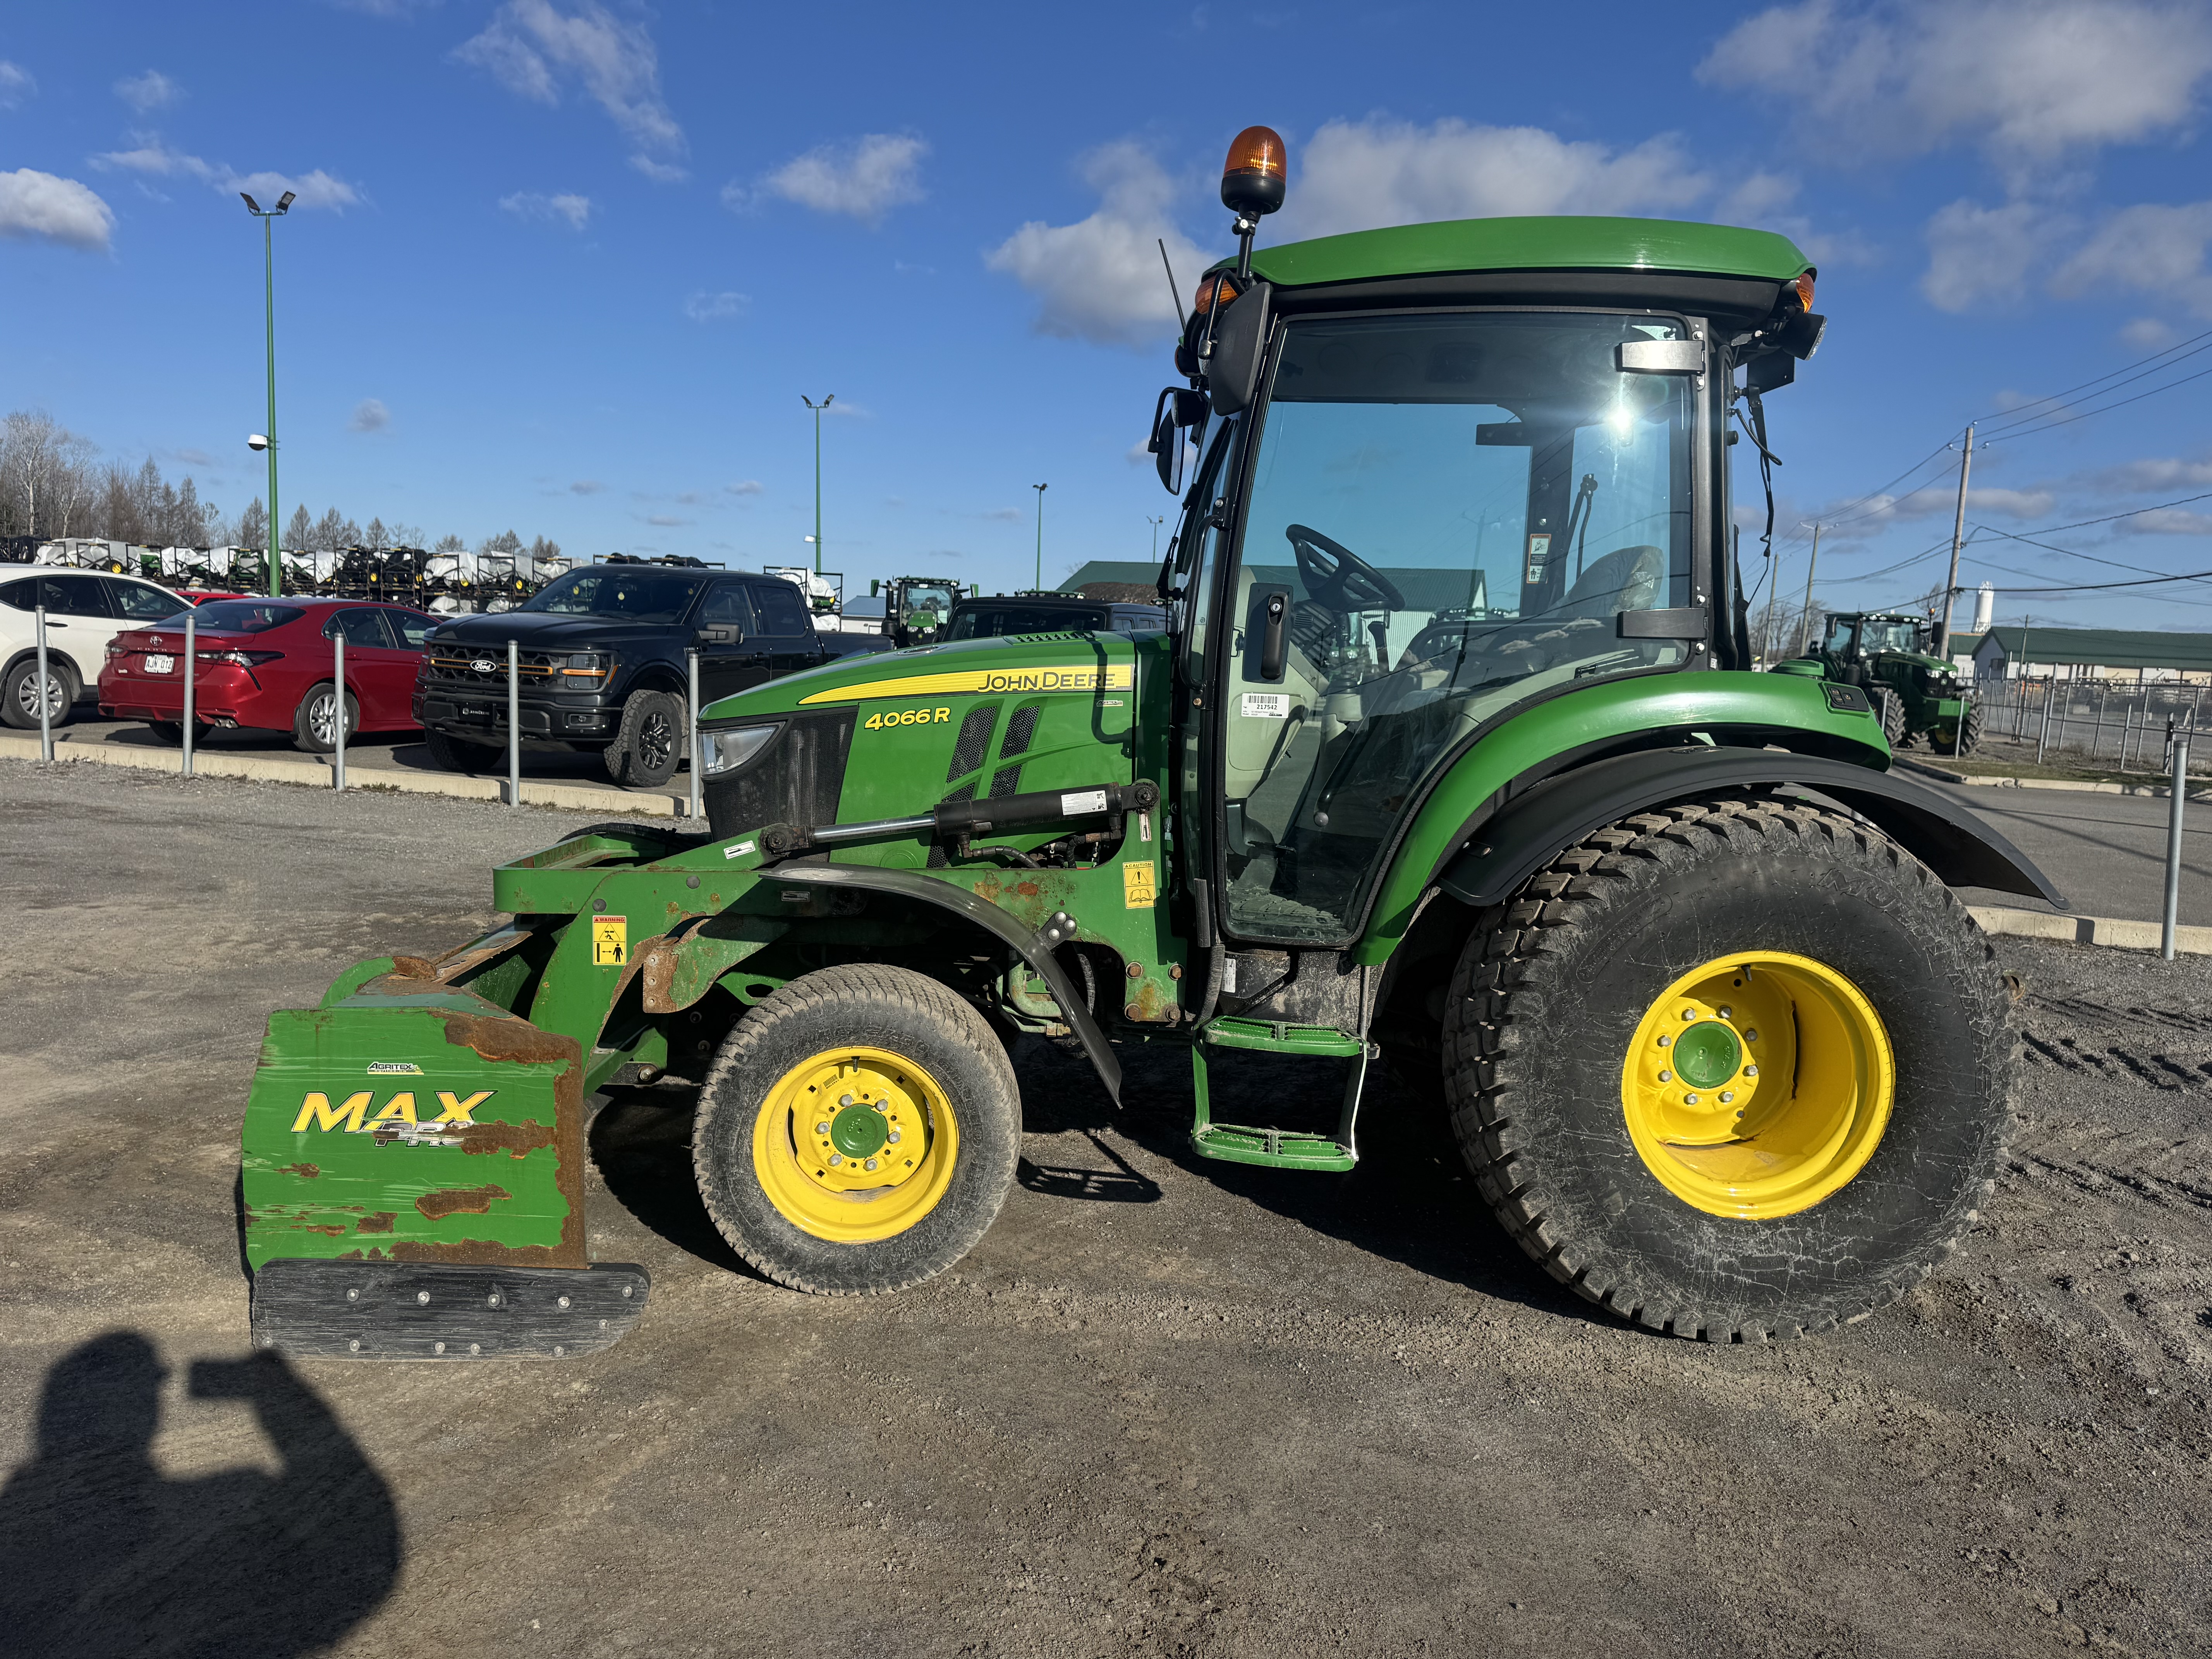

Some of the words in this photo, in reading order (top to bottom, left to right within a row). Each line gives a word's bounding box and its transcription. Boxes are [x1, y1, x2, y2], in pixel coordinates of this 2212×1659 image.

[475, 661, 491, 670] Ford
[978, 674, 1038, 690] JOHN
[1043, 672, 1116, 688] DEERE
[290, 1090, 498, 1133] MAX
